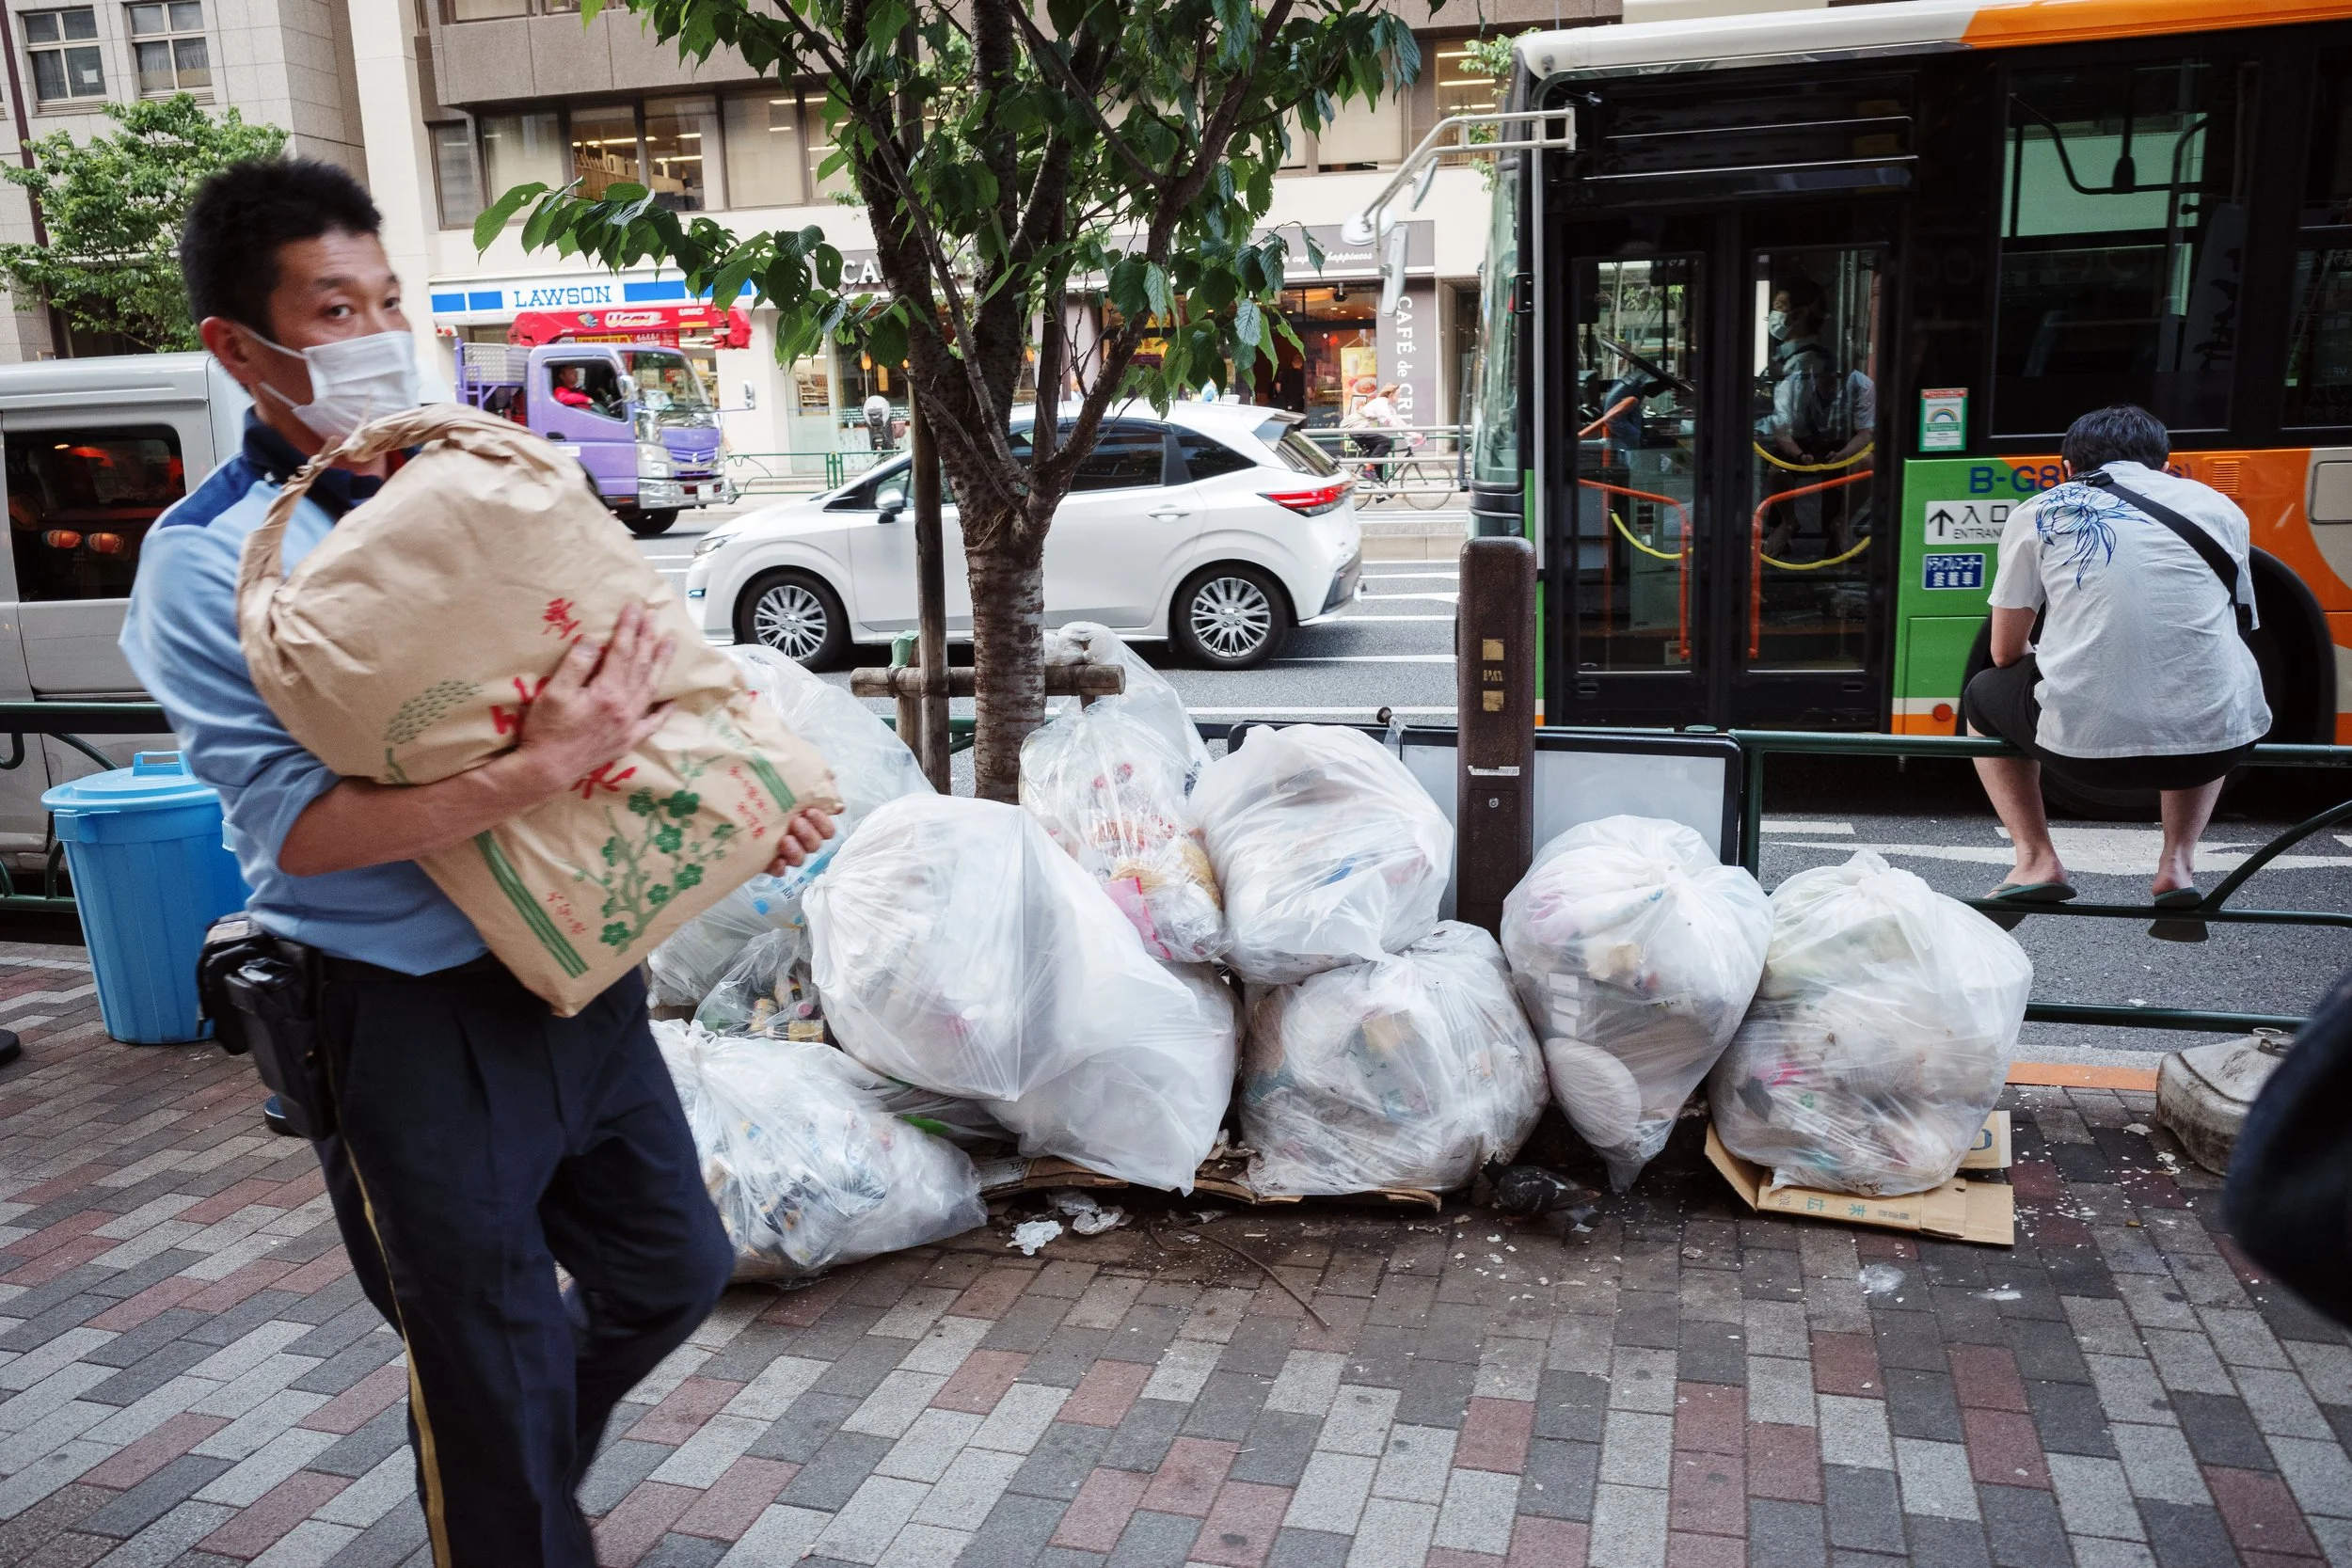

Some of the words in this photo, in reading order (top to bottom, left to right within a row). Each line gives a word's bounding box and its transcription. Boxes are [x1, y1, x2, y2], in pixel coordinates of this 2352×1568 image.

[840, 259, 882, 284] CA
[514, 285, 612, 308] LAWSON
[1396, 295, 1417, 356] CAFÉ
[1396, 360, 1413, 377] de
[1961, 504, 2010, 525] 入口
[1953, 528, 2004, 539] ENTRAN
